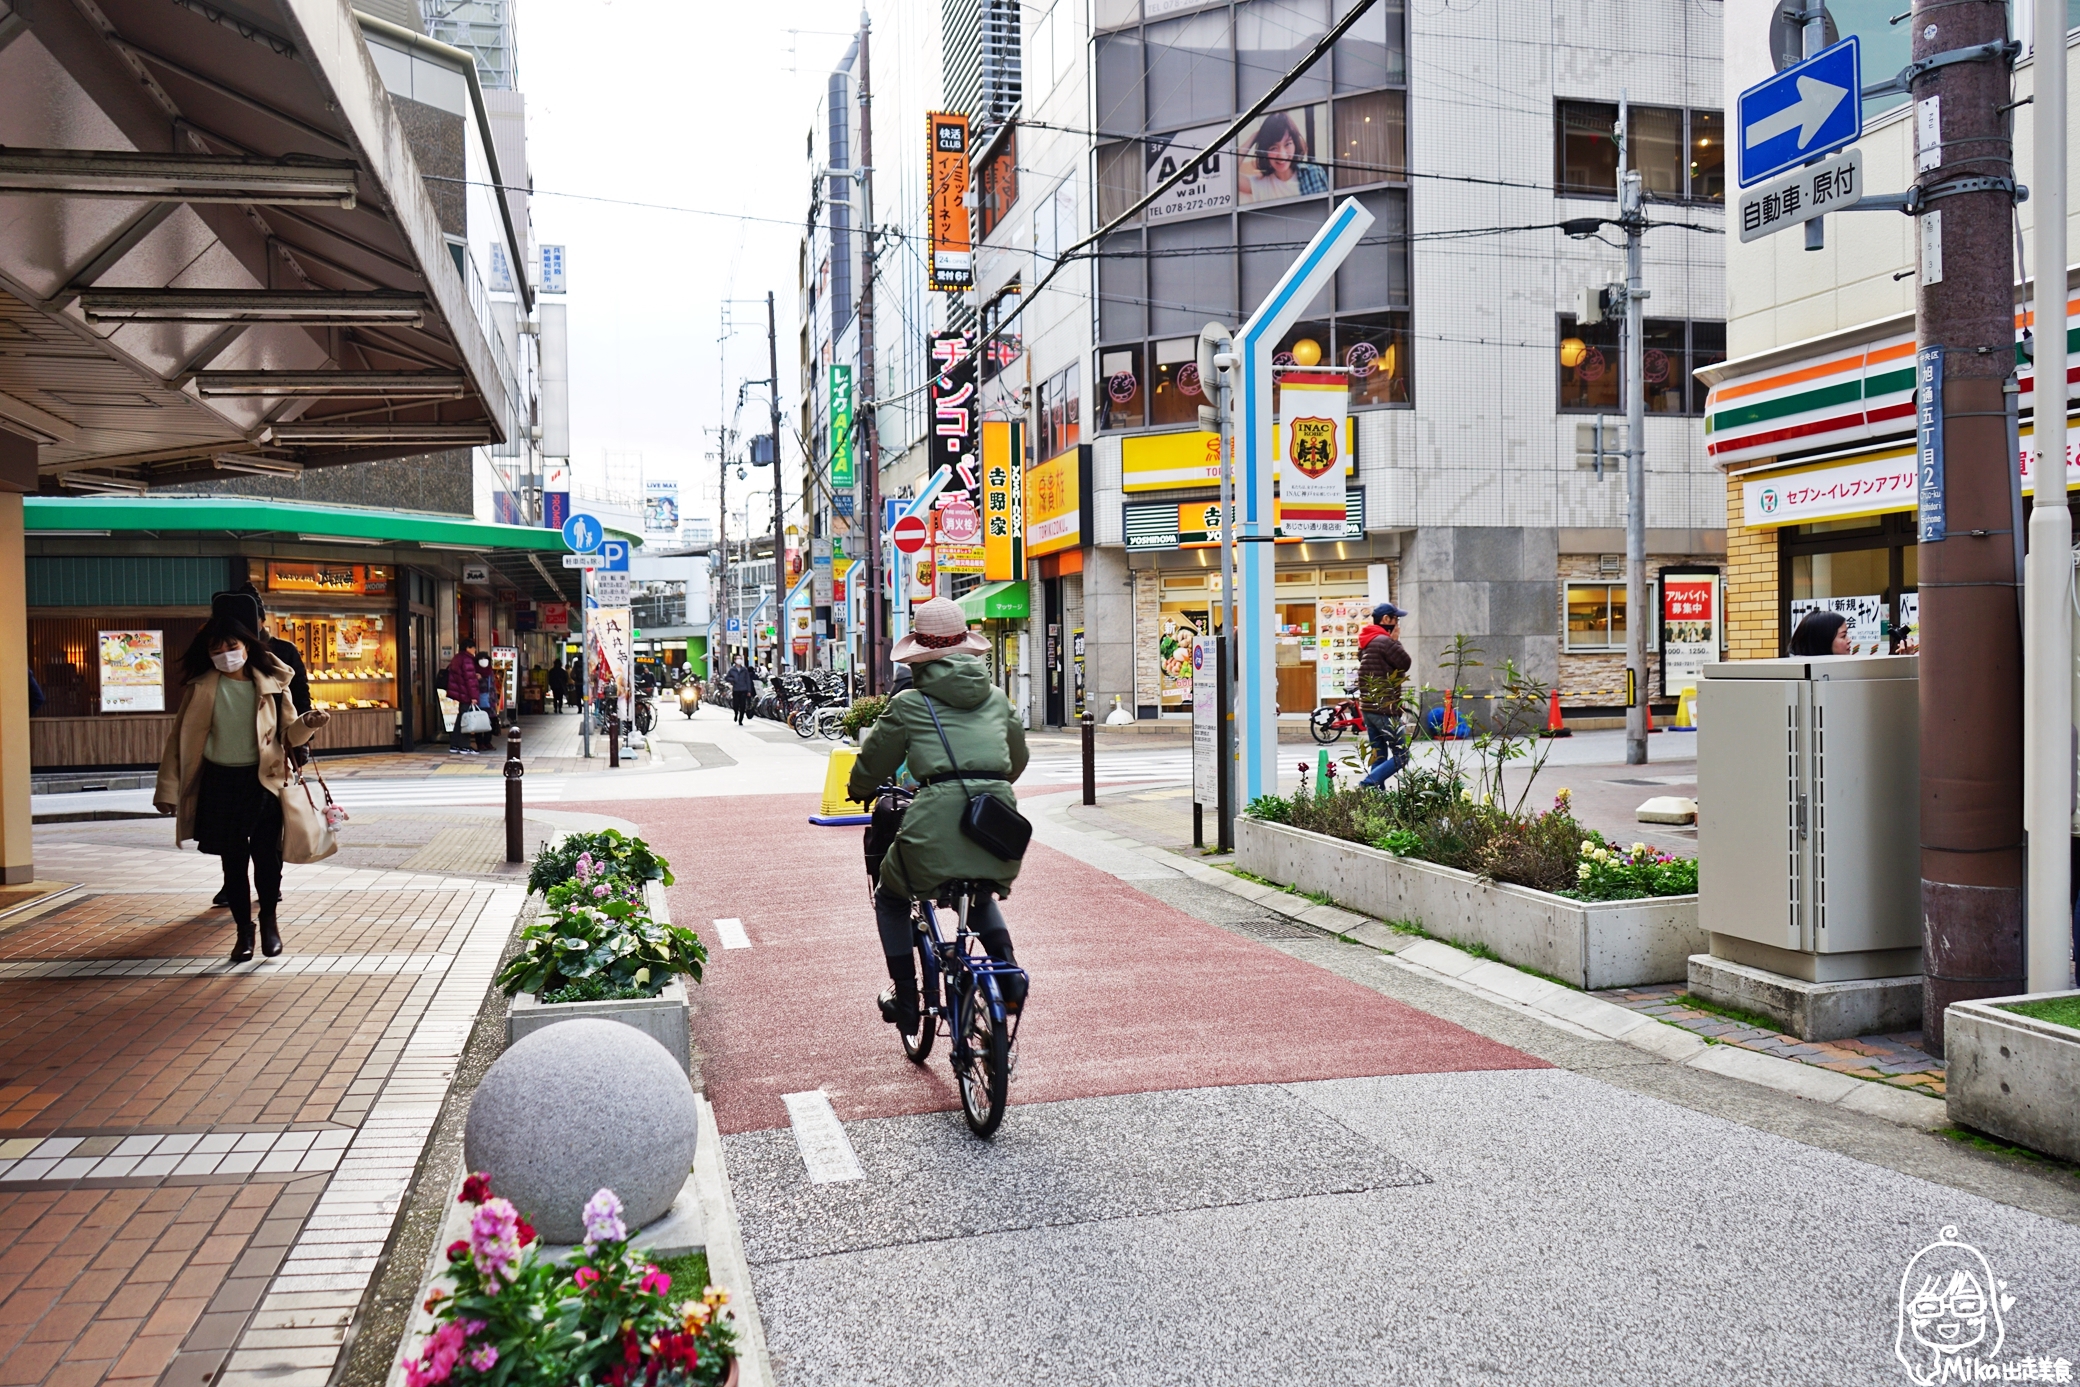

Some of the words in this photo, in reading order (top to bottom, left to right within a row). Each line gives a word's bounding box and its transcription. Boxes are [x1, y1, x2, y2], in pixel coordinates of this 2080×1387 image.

[940, 128, 961, 139] 快活
[940, 139, 961, 148] CLUB
[953, 158, 964, 207] コミック
[1177, 185, 1205, 197] wall
[1743, 162, 1855, 232] 自動車・原付
[939, 158, 951, 245] インターネット
[1150, 207, 1163, 216] TEL
[1166, 195, 1230, 213] 078-272-0729
[1920, 351, 1939, 361] 中央区
[833, 368, 848, 412] レイク
[834, 414, 848, 472] ALSA
[1787, 473, 1918, 505] セブン-イレブンアプリ
[988, 467, 1007, 537] 吉野家
[1012, 465, 1021, 537] YOSHINOYA
[946, 518, 973, 530] 消火栓
[1286, 523, 1341, 531] あじさい通り商店街
[1927, 527, 1933, 537] 2
[1130, 535, 1176, 545] YOSHINOYA
[605, 543, 623, 568] P
[1666, 590, 1708, 601] アルバイト
[1672, 603, 1702, 614] 募集中
[1835, 599, 1856, 611] 新規
[729, 619, 738, 631] P
[1164, 621, 1176, 634] 新
